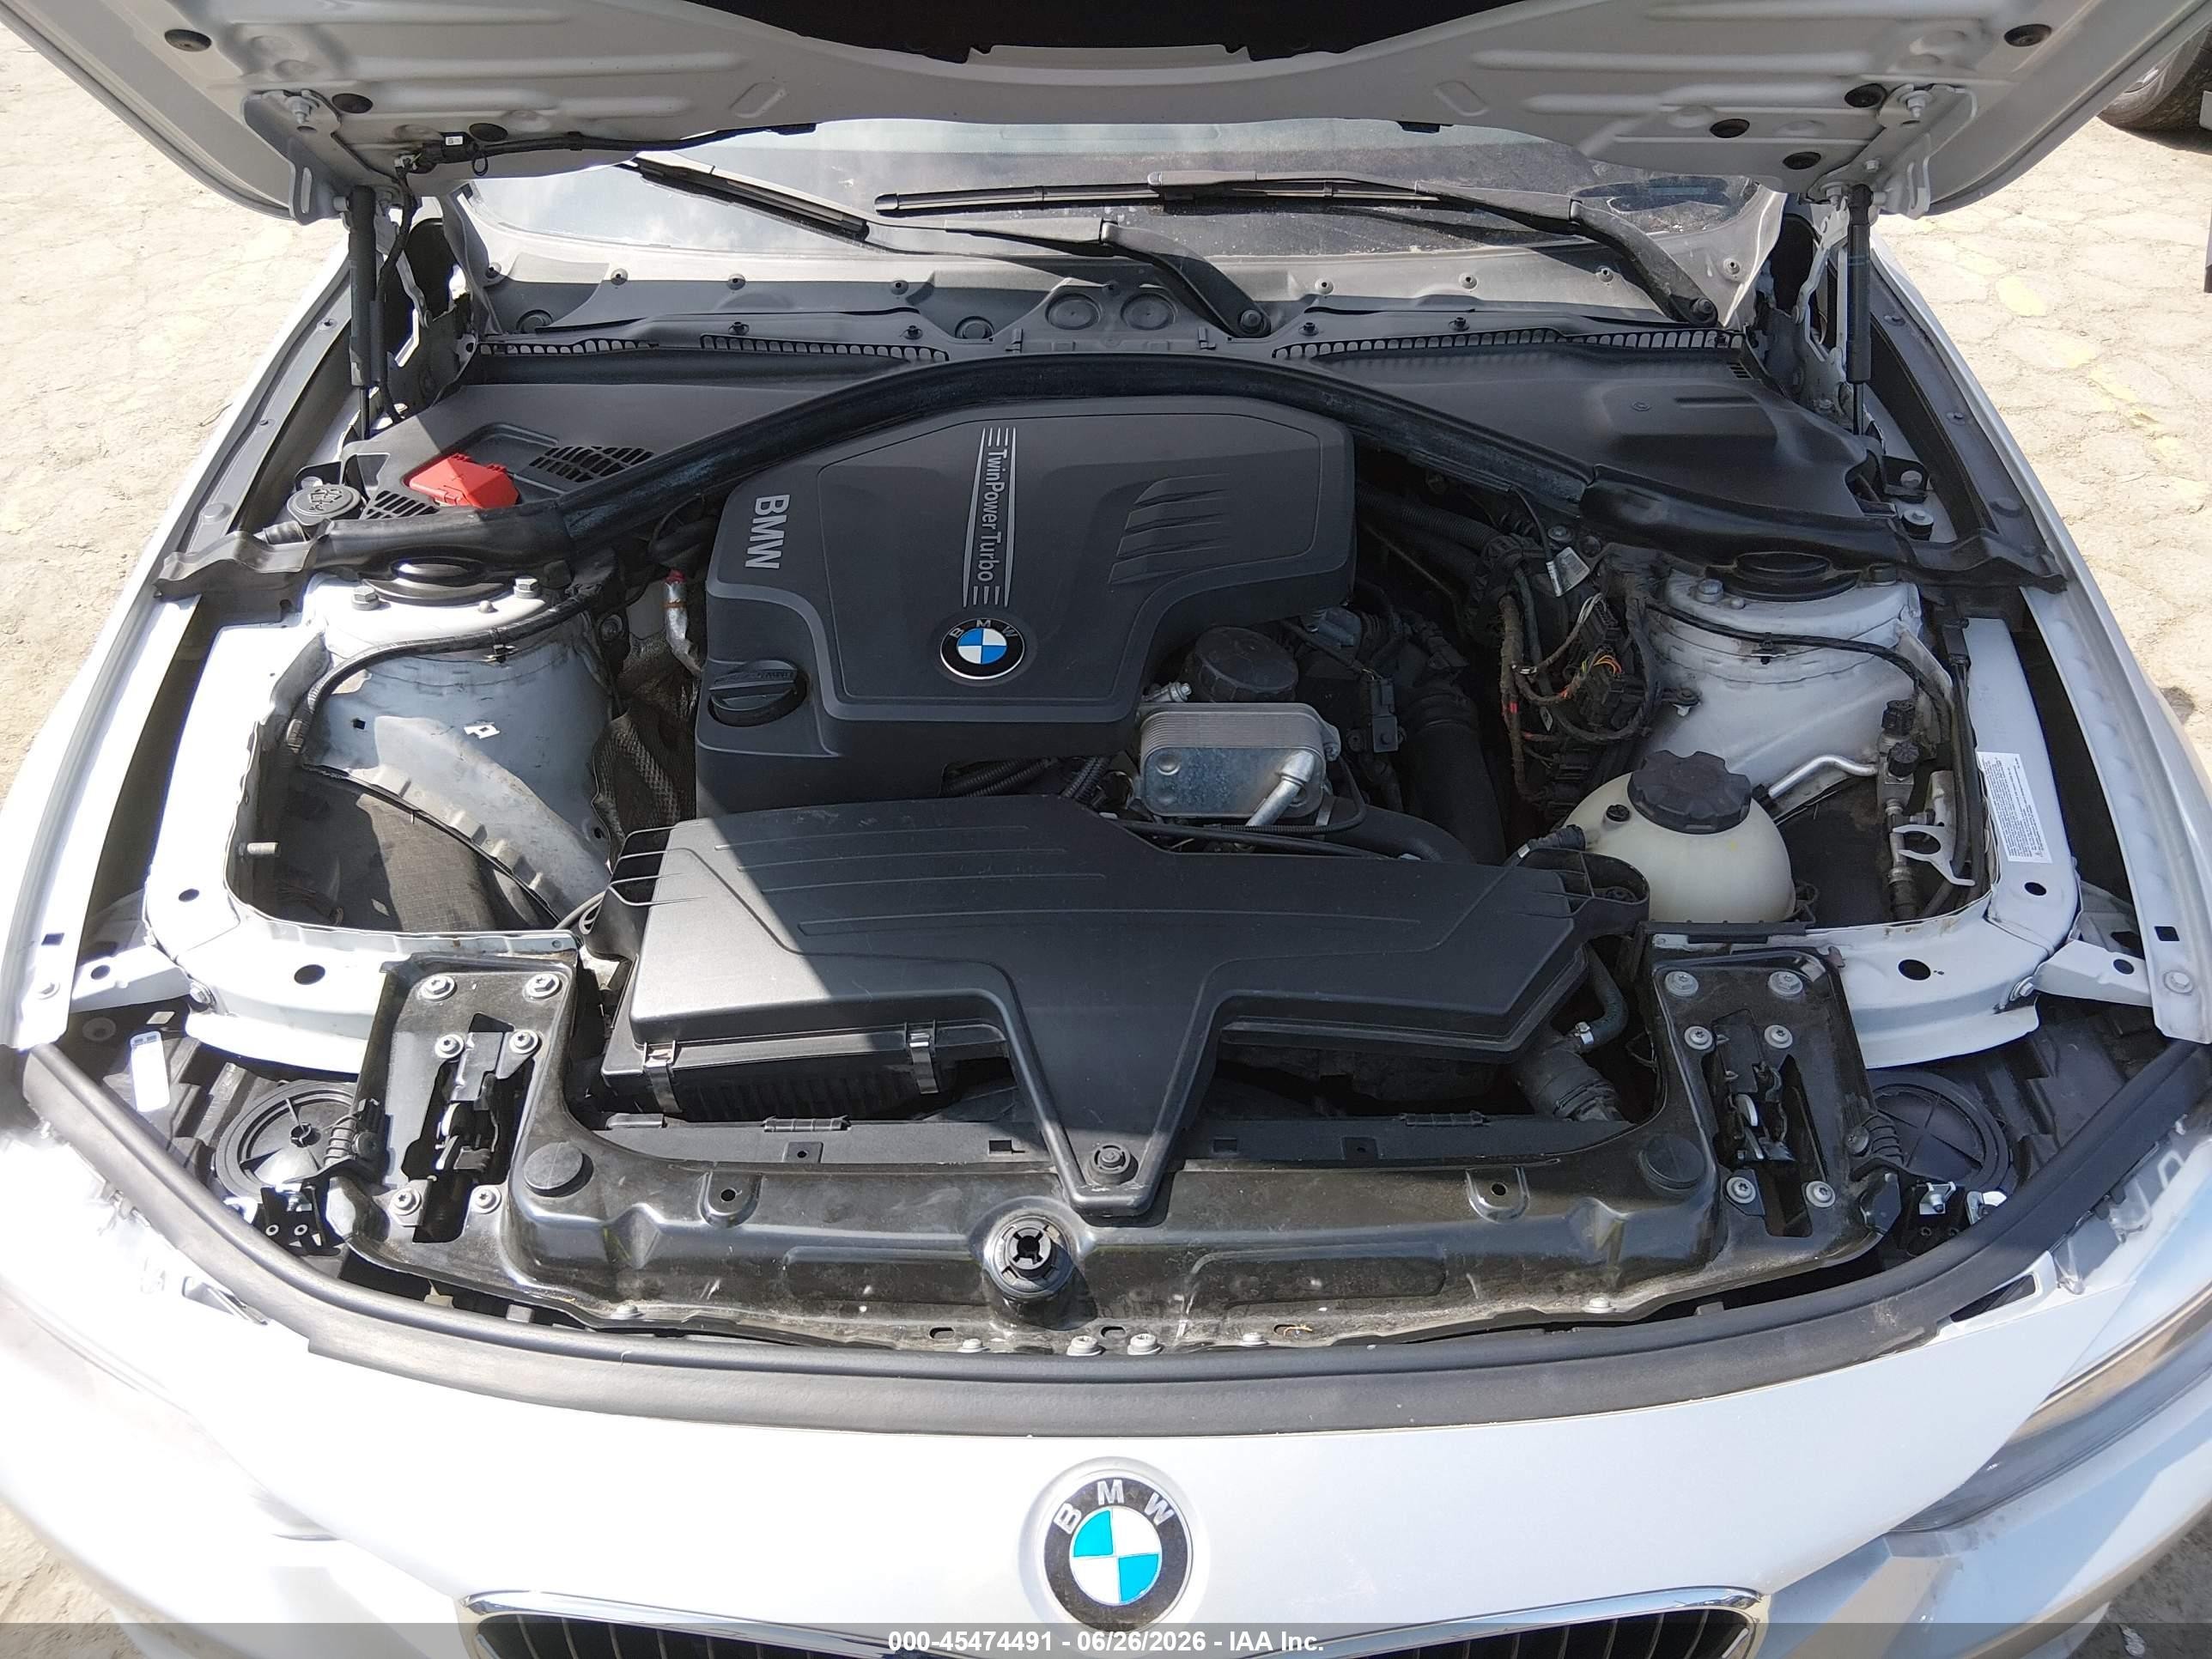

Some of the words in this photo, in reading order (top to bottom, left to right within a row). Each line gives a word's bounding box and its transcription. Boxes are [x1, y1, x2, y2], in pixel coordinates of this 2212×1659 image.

[981, 448, 1008, 530] TwinPower
[745, 494, 790, 568] BMW
[977, 531, 1002, 582] Turbo
[949, 619, 1018, 638] BMW
[1053, 1479, 1175, 1534] BMW
